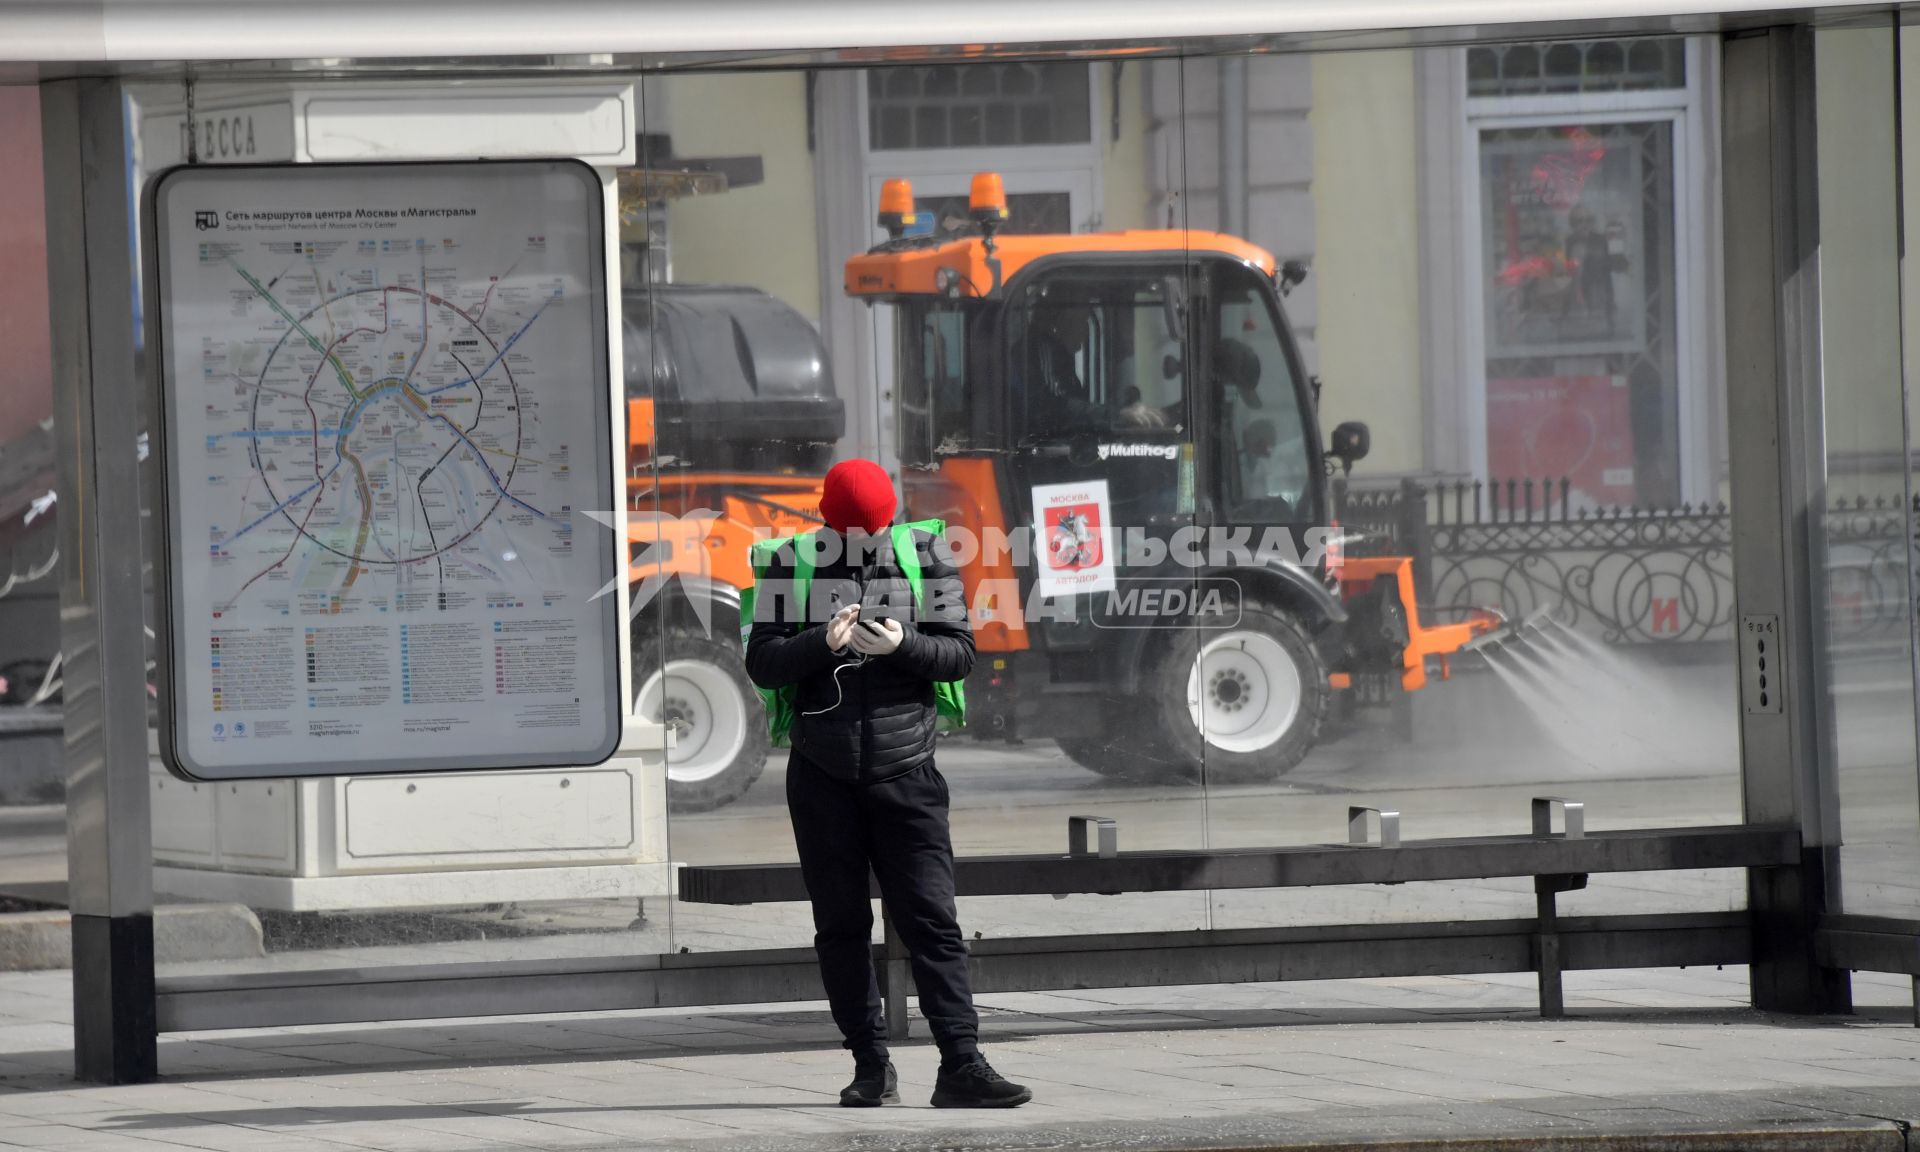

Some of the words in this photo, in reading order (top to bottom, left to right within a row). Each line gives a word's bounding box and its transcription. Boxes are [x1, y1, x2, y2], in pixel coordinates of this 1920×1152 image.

[179, 115, 256, 159] ПЕССА
[225, 210, 250, 221] Сеть
[252, 210, 312, 222] маршрутов
[314, 209, 352, 220] центра
[354, 208, 398, 219] Москвы
[400, 207, 476, 218] «Магистраль»
[254, 223, 286, 231] Transport
[288, 222, 317, 230] Network
[329, 221, 357, 229] Moscow
[359, 221, 372, 230] City
[374, 220, 397, 228] Center
[1110, 443, 1178, 460] Multihog
[1050, 493, 1090, 504] МОСКВА
[1055, 573, 1098, 585] АВТОДОР
